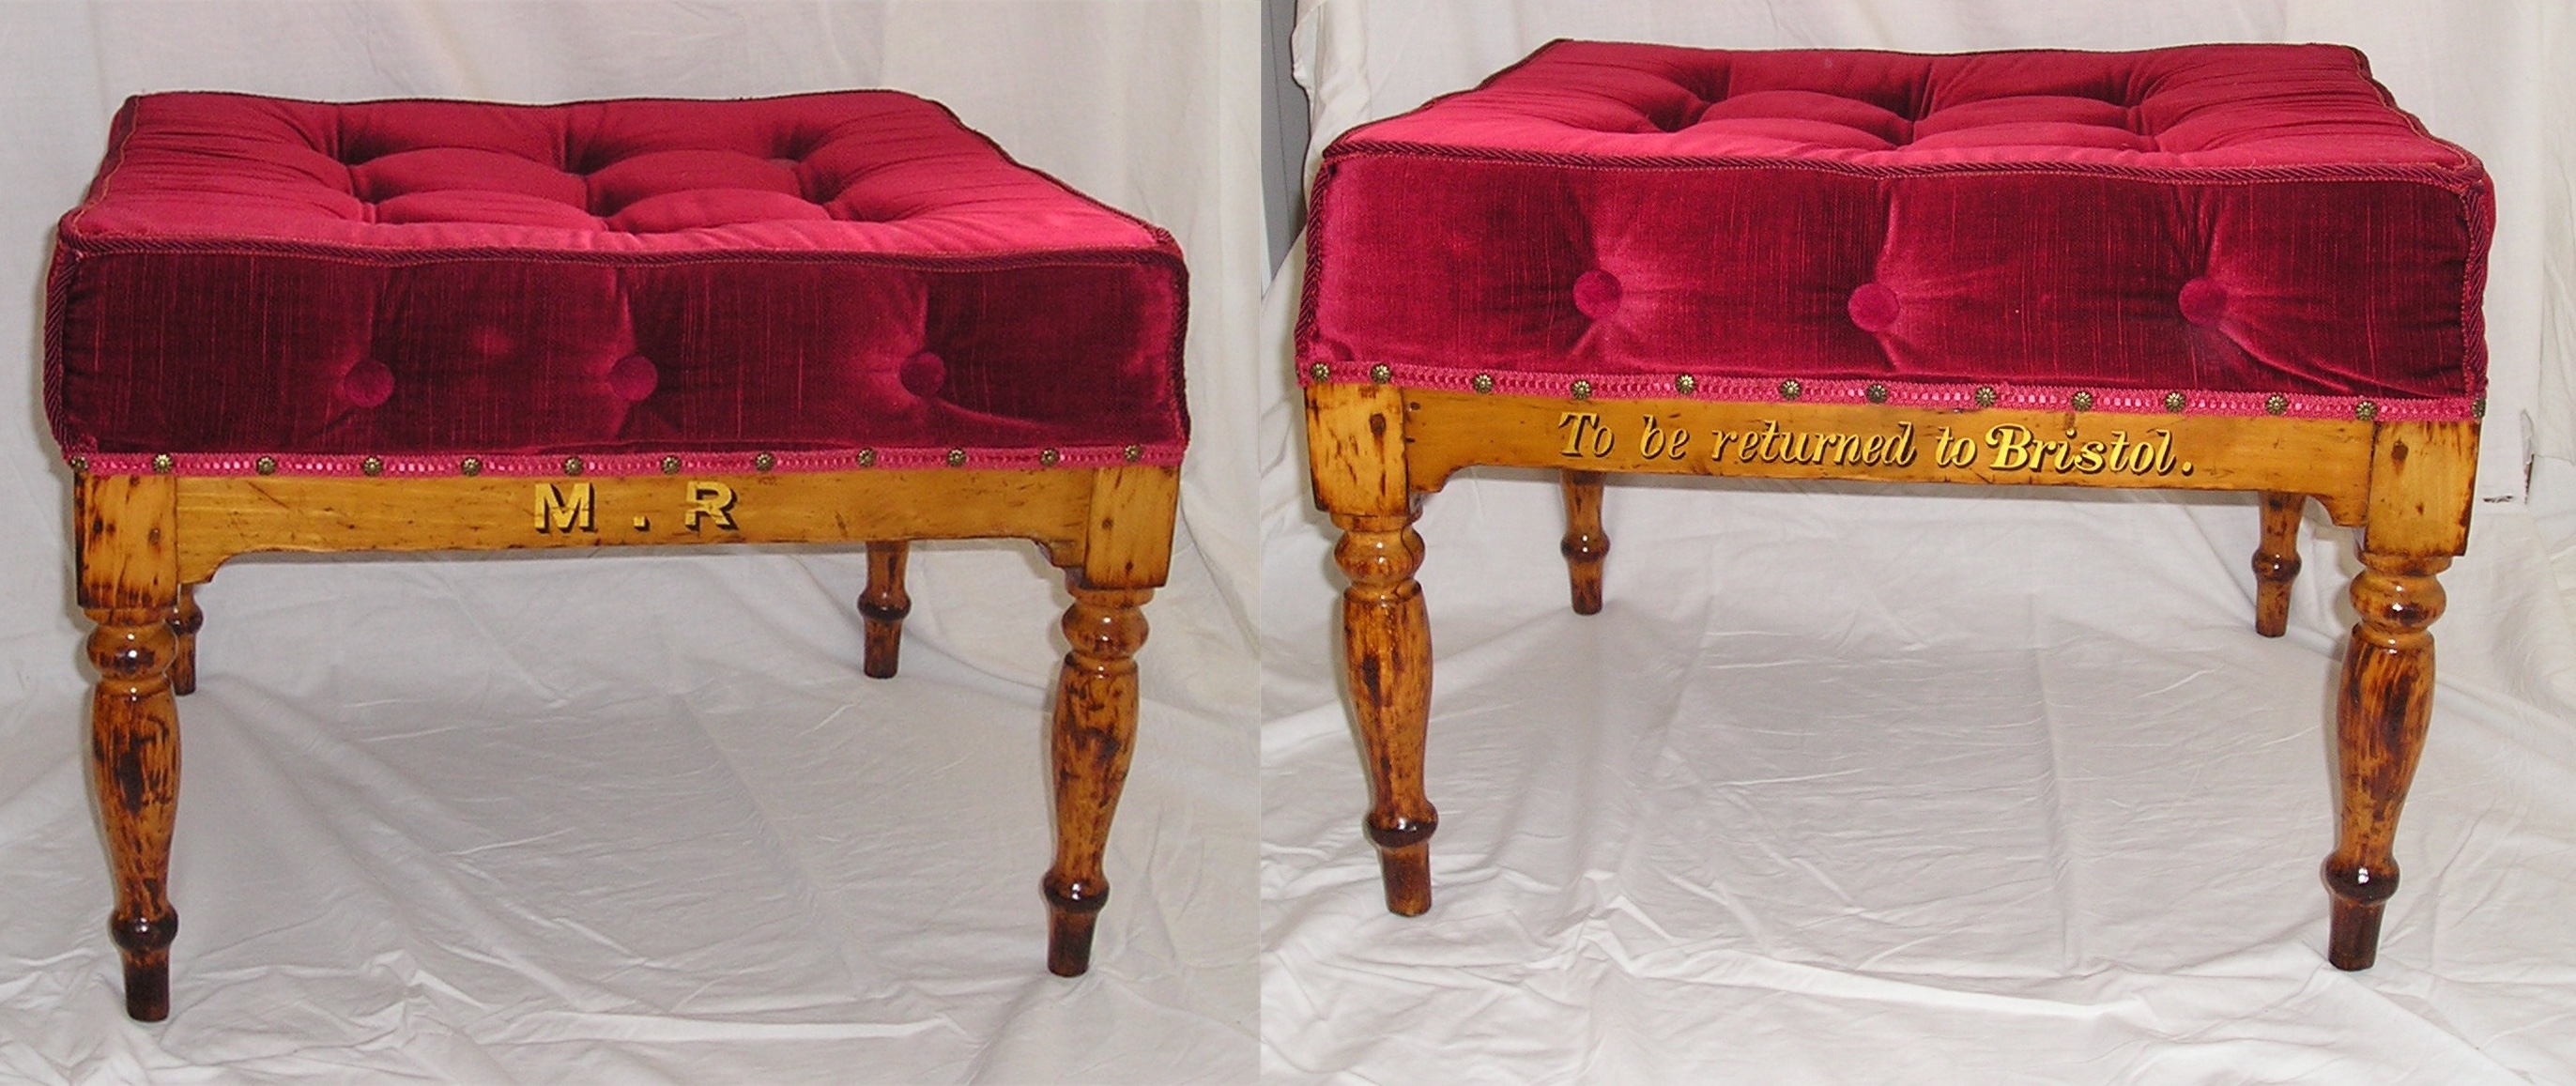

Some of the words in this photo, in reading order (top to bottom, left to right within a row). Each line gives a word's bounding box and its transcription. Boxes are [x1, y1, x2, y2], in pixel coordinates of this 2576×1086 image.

[1558, 411, 1616, 458] To
[1640, 413, 1690, 460] be
[1711, 420, 1917, 467] returned
[1936, 426, 1978, 468] to
[1986, 423, 2194, 476] Bristol.
